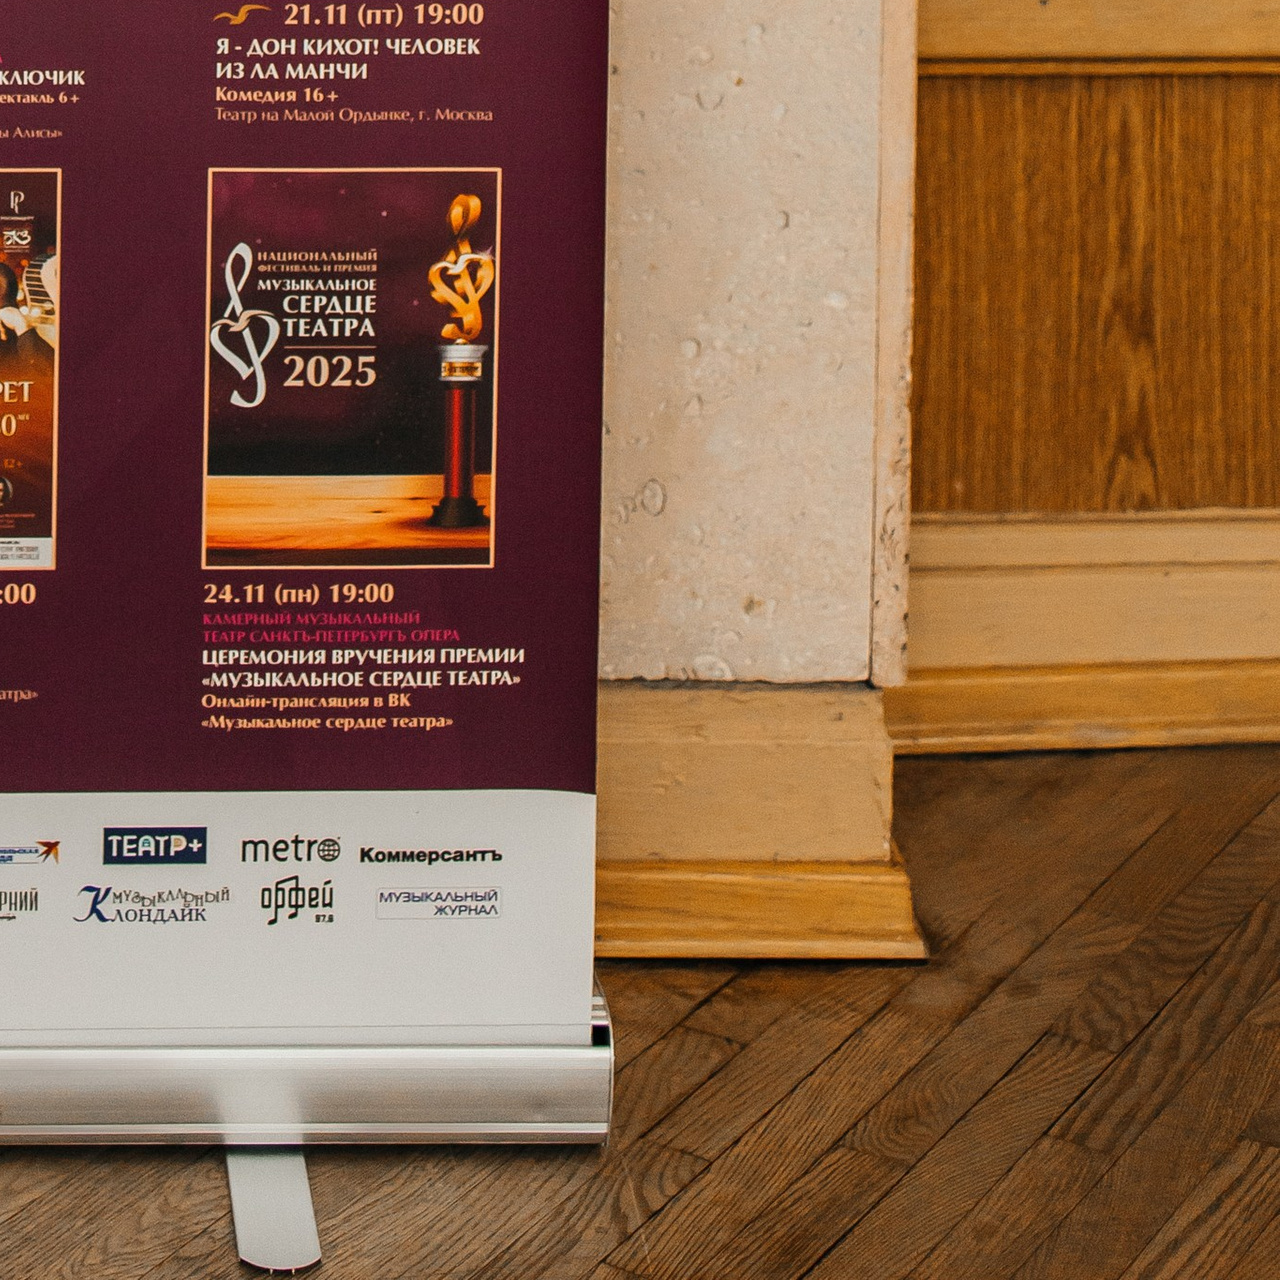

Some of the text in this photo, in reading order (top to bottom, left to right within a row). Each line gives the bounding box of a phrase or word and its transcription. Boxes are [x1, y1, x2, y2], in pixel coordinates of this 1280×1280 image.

[285, 3, 484, 27] 21.11 (пт) 19:00
[217, 38, 229, 54] Я
[247, 39, 296, 57] ДОН
[303, 39, 378, 55] КИХОТ!
[386, 38, 480, 54] ЧЕЛОВЕК
[216, 62, 367, 79] ИЗ ЛА МАНЧИ
[257, 279, 377, 291] МУЗЫКАЛЬНОЕ
[282, 295, 377, 315] СЕРДЦЕ
[283, 319, 375, 337] ТЕАТРА
[283, 355, 377, 387] 2025
[204, 584, 394, 605] 24.11 (пн) 19:00
[203, 648, 524, 667] ЦЕРЕМОНИЯ ВРУЧЕНИЯ ПРЕМИИ
[202, 670, 520, 688] «МУЗЫКАЛЬНОЕ СЕРДЦЕ ТЕАТРА»
[108, 835, 202, 857] ТЕАТР+
[360, 848, 502, 864] Коммерсантъ
